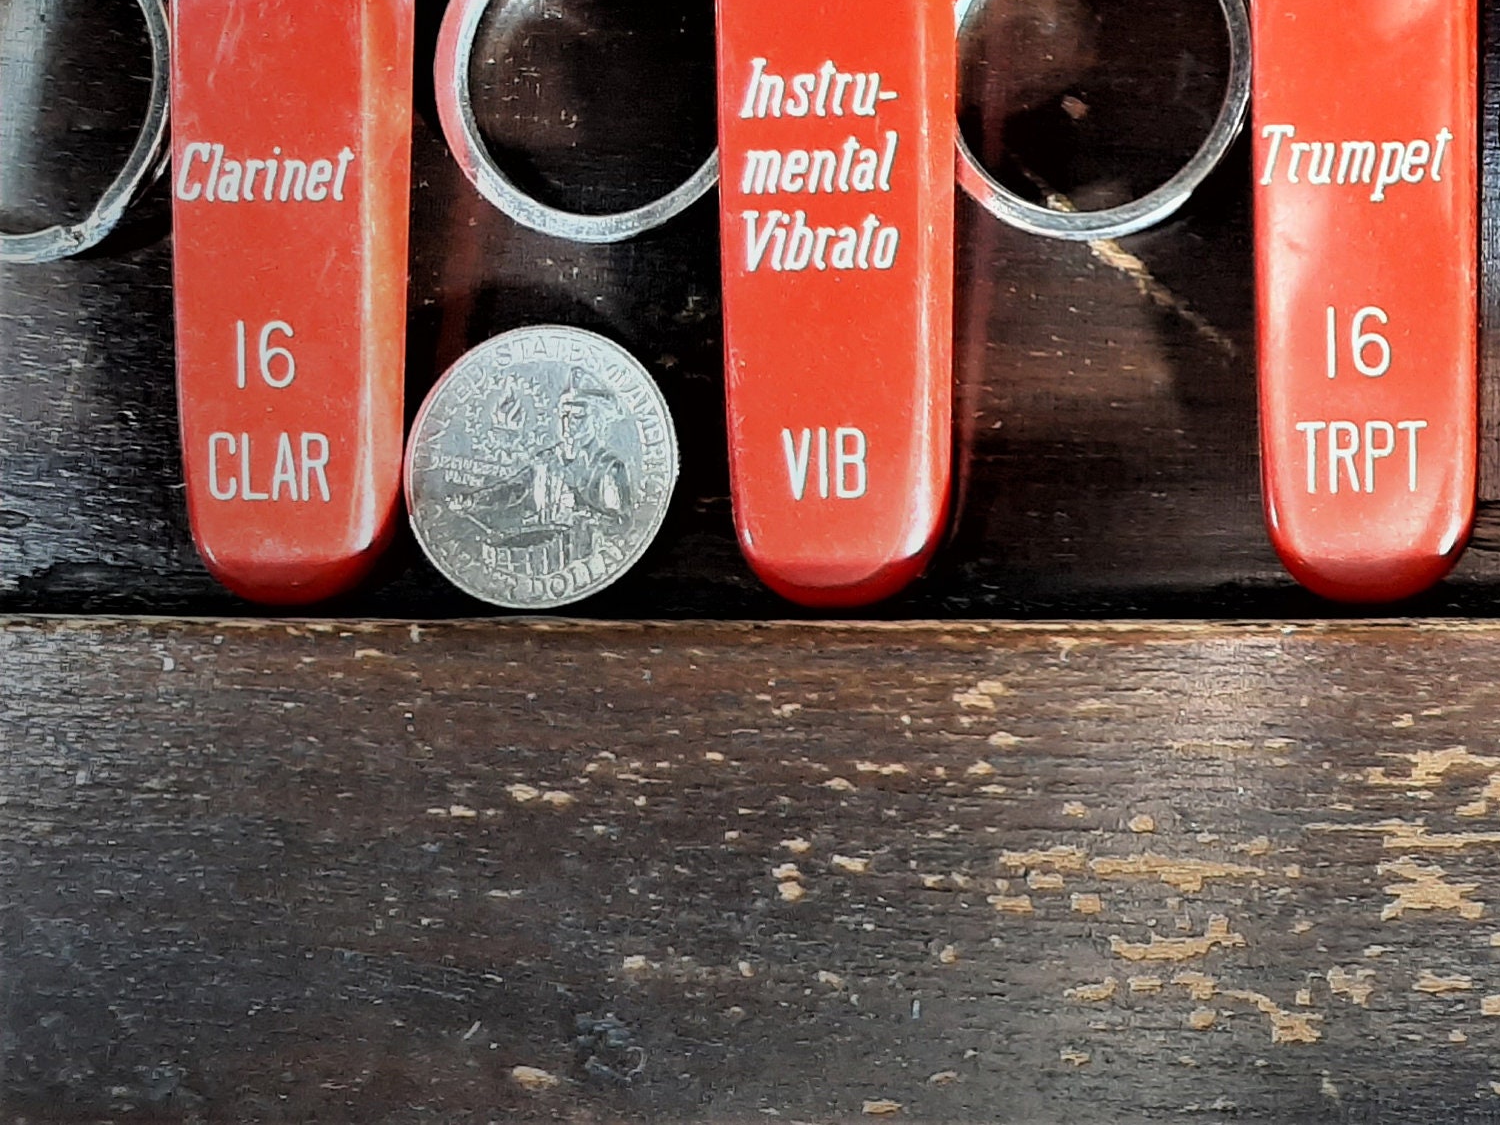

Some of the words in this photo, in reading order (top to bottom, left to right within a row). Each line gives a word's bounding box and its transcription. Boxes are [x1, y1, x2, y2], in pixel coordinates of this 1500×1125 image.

[740, 58, 899, 119] Instru-
[176, 141, 355, 202] Clarinet
[742, 130, 900, 195] mental
[1259, 124, 1454, 202] Trumpet
[742, 209, 900, 272] Vibrato
[235, 319, 296, 389] 16
[1325, 306, 1392, 379] 16
[208, 432, 331, 502] CLAR
[781, 426, 867, 502] VIB
[1295, 420, 1428, 495] TRPT
